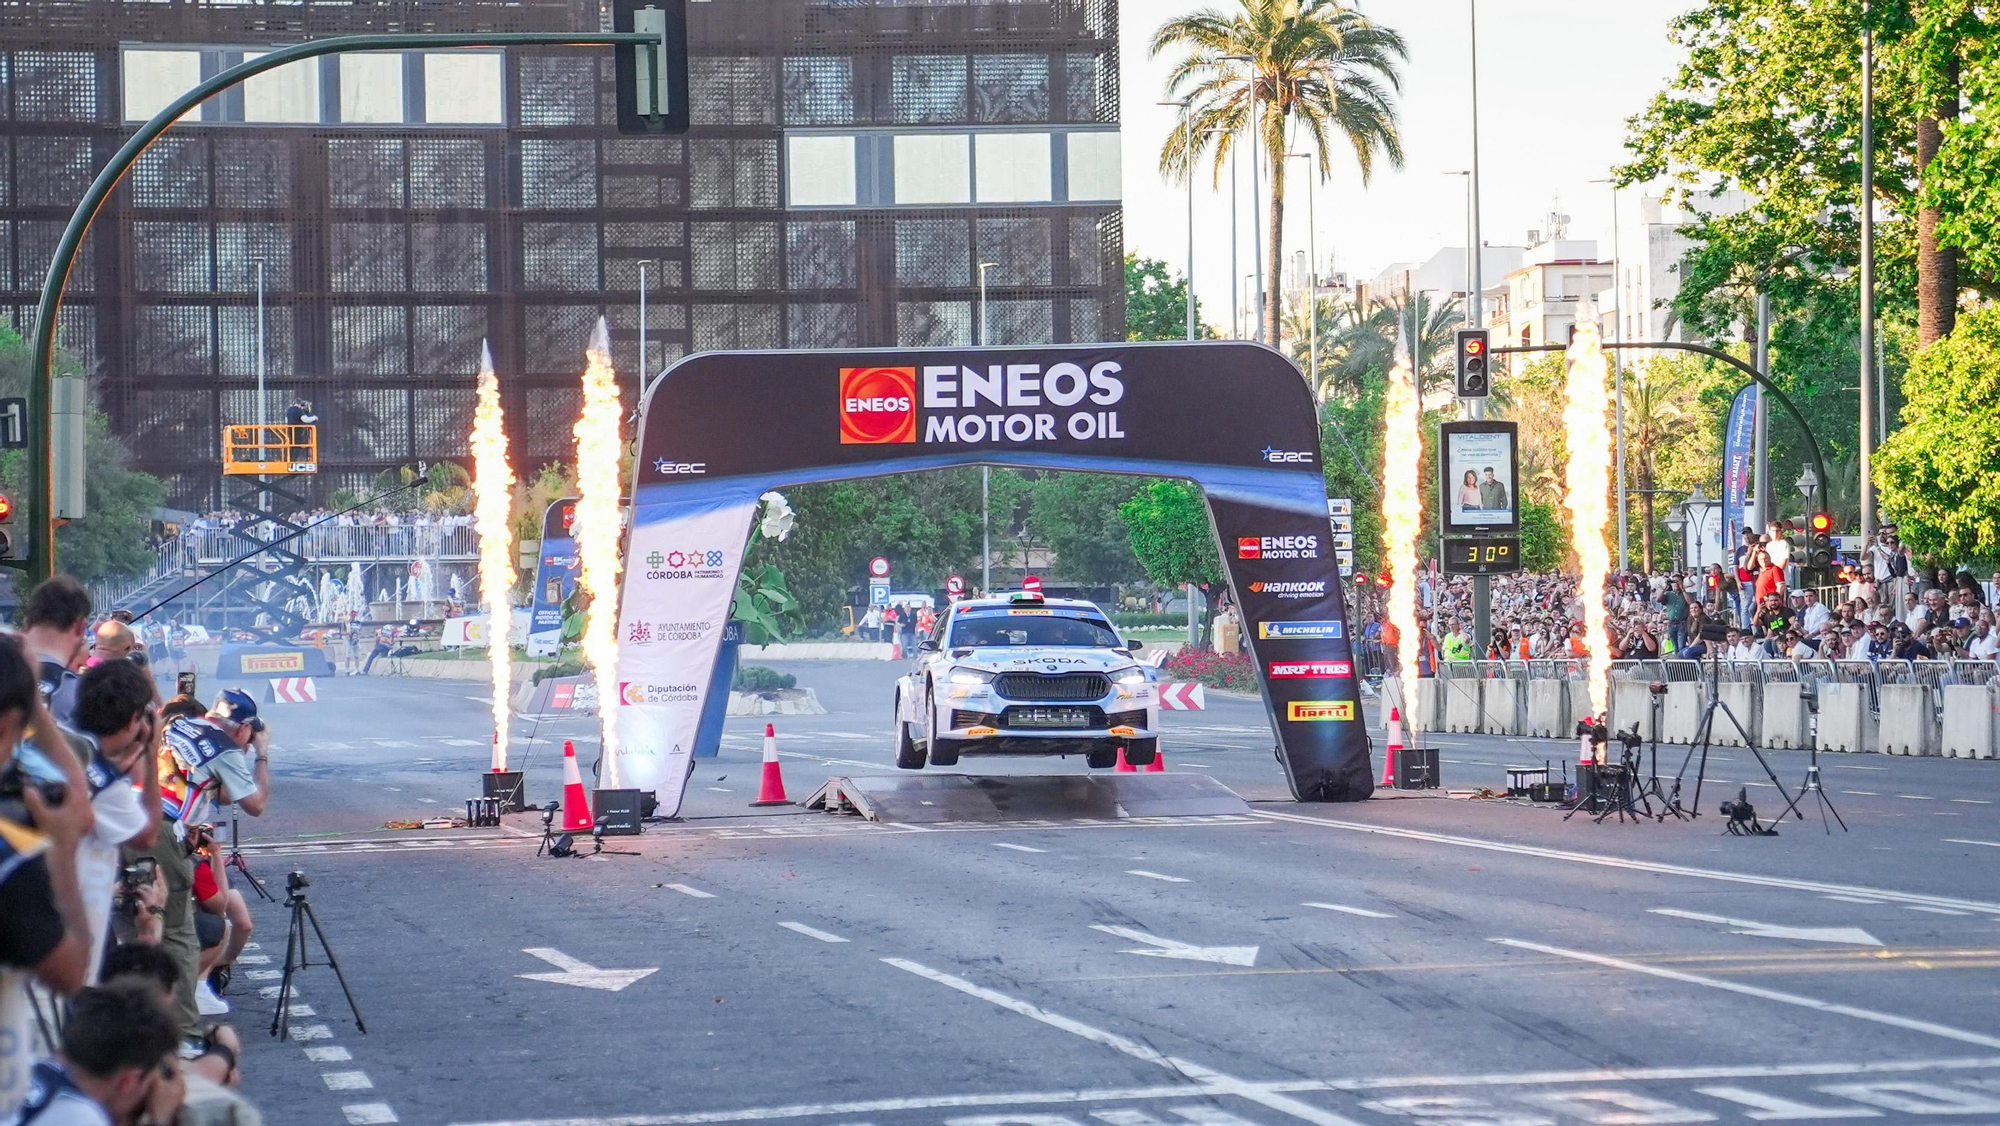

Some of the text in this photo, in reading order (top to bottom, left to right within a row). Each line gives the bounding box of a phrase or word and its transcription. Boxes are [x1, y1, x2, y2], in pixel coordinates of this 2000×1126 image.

[924, 361, 1124, 407] ENEOS
[846, 397, 910, 412] ENEOS
[924, 412, 1124, 443] MOTOR OIL
[1268, 452, 1313, 462] ERC
[288, 463, 315, 472] JCB
[660, 463, 706, 474] ERC
[1261, 536, 1317, 549] ENEOS
[1262, 550, 1317, 559] MOTOR OIL
[646, 570, 693, 579] CÓRDOBA
[875, 588, 886, 602] P
[658, 622, 710, 631] AYUNTAMIENTO
[668, 631, 702, 640] CÓRDOBA
[247, 656, 298, 670] PIRELLI
[1272, 664, 1348, 675] MRF TYRES
[648, 684, 697, 694] Diputación
[661, 693, 698, 702] Córdoba
[1294, 705, 1348, 717] PIRELLI
[199, 740, 214, 756] FIA
